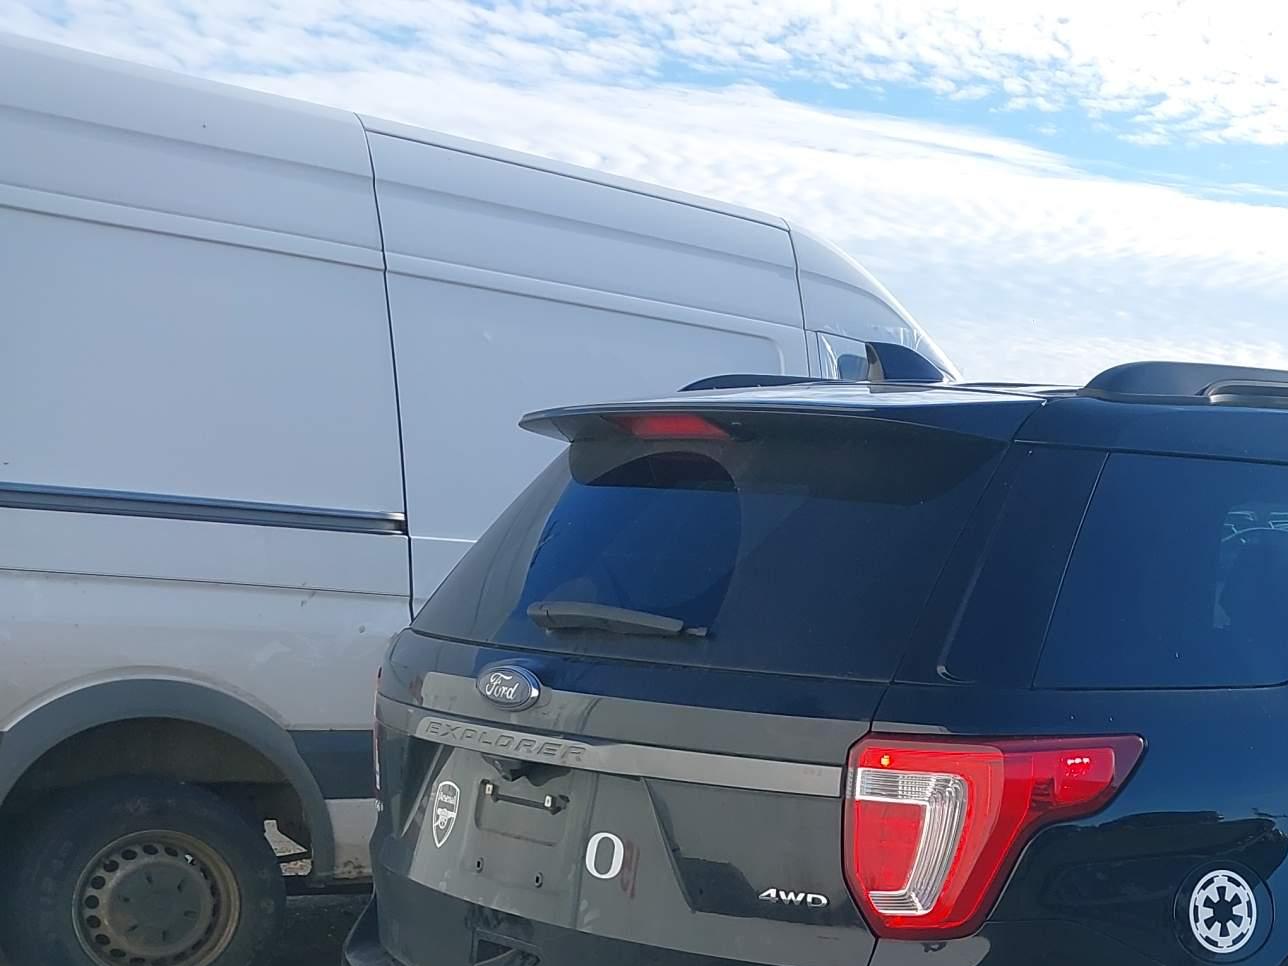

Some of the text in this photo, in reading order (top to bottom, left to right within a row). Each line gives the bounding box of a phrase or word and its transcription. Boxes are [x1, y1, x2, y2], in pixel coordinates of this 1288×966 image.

[485, 672, 520, 700] Ford
[425, 721, 588, 763] EXPLORER
[758, 888, 829, 908] 4WD
